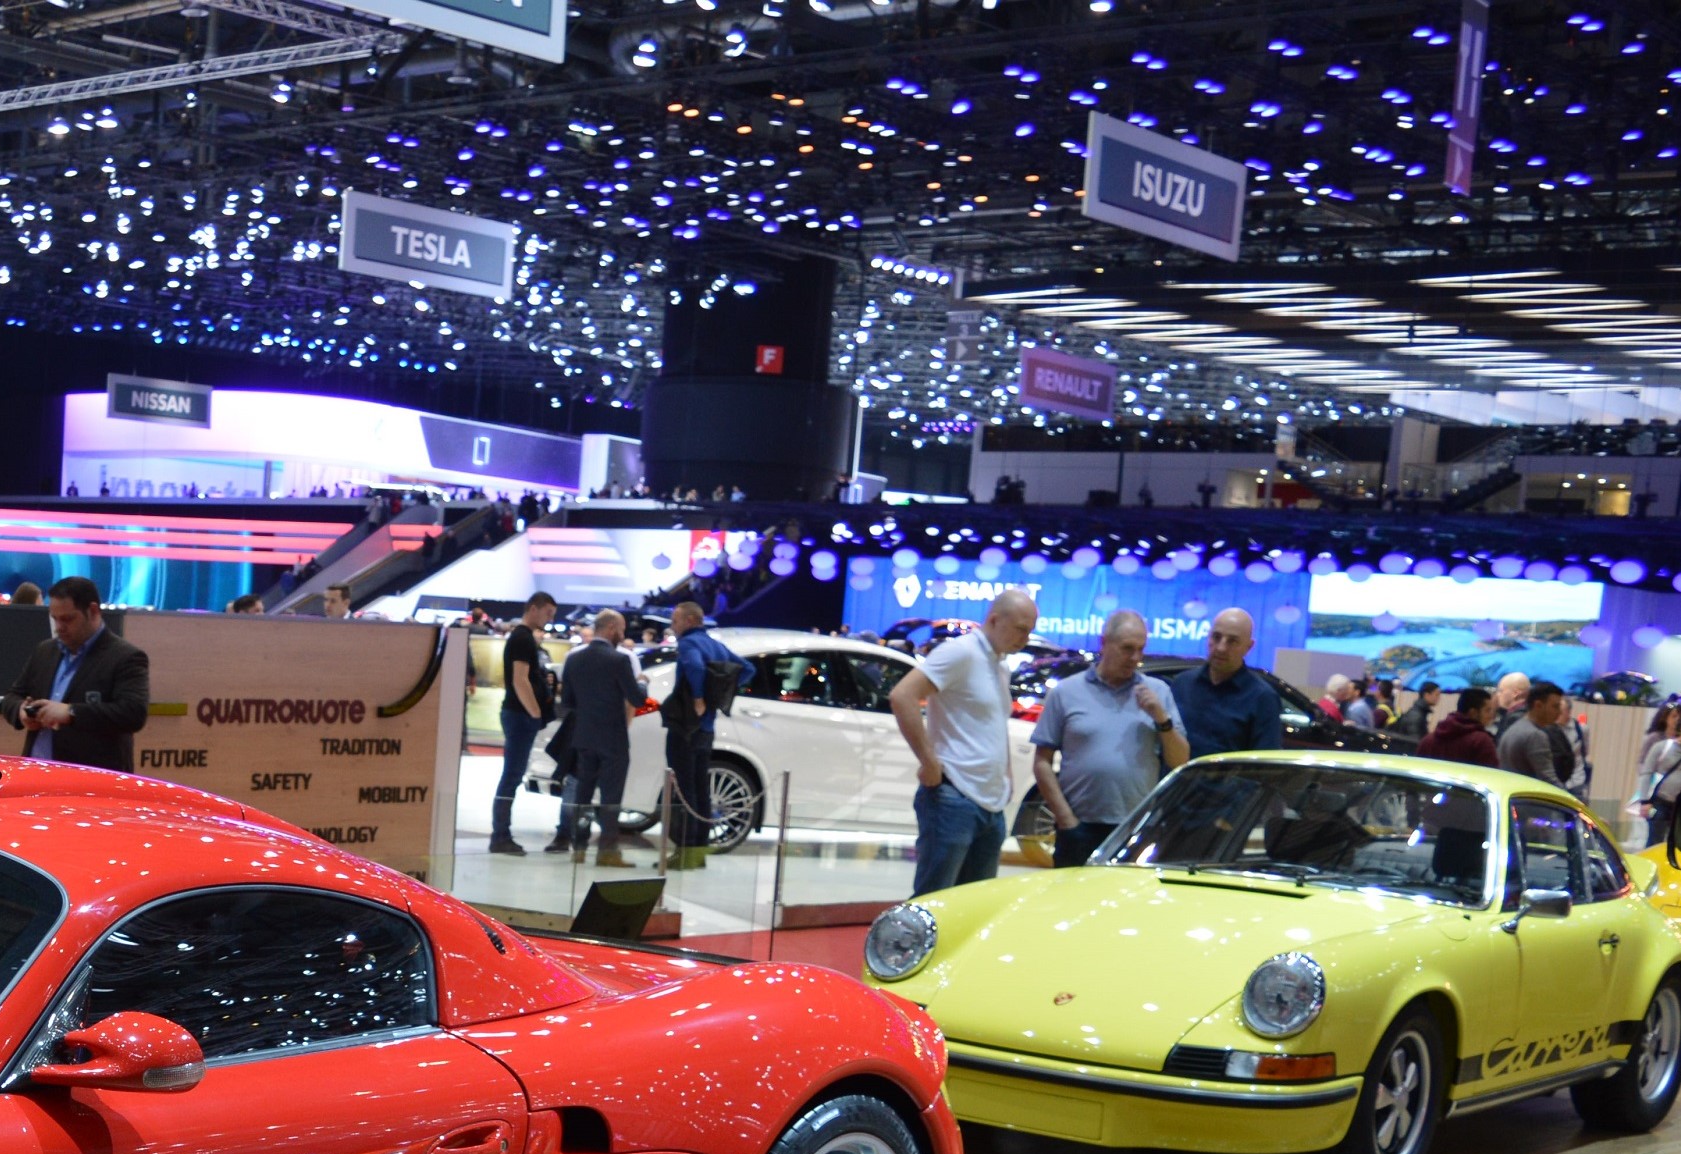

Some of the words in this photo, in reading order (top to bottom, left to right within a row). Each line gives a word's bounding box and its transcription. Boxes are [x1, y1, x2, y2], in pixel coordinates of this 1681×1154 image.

[1132, 160, 1206, 218] ISUZU
[390, 225, 472, 270] TESLA
[1033, 366, 1103, 402] RENAULT
[130, 389, 192, 416] NISSAN
[140, 749, 209, 769] FUTURE
[320, 738, 402, 756] TRADITION
[250, 772, 313, 792] SAFETY
[358, 785, 430, 804] MOBILITY
[1481, 1027, 1611, 1079] Carrera
